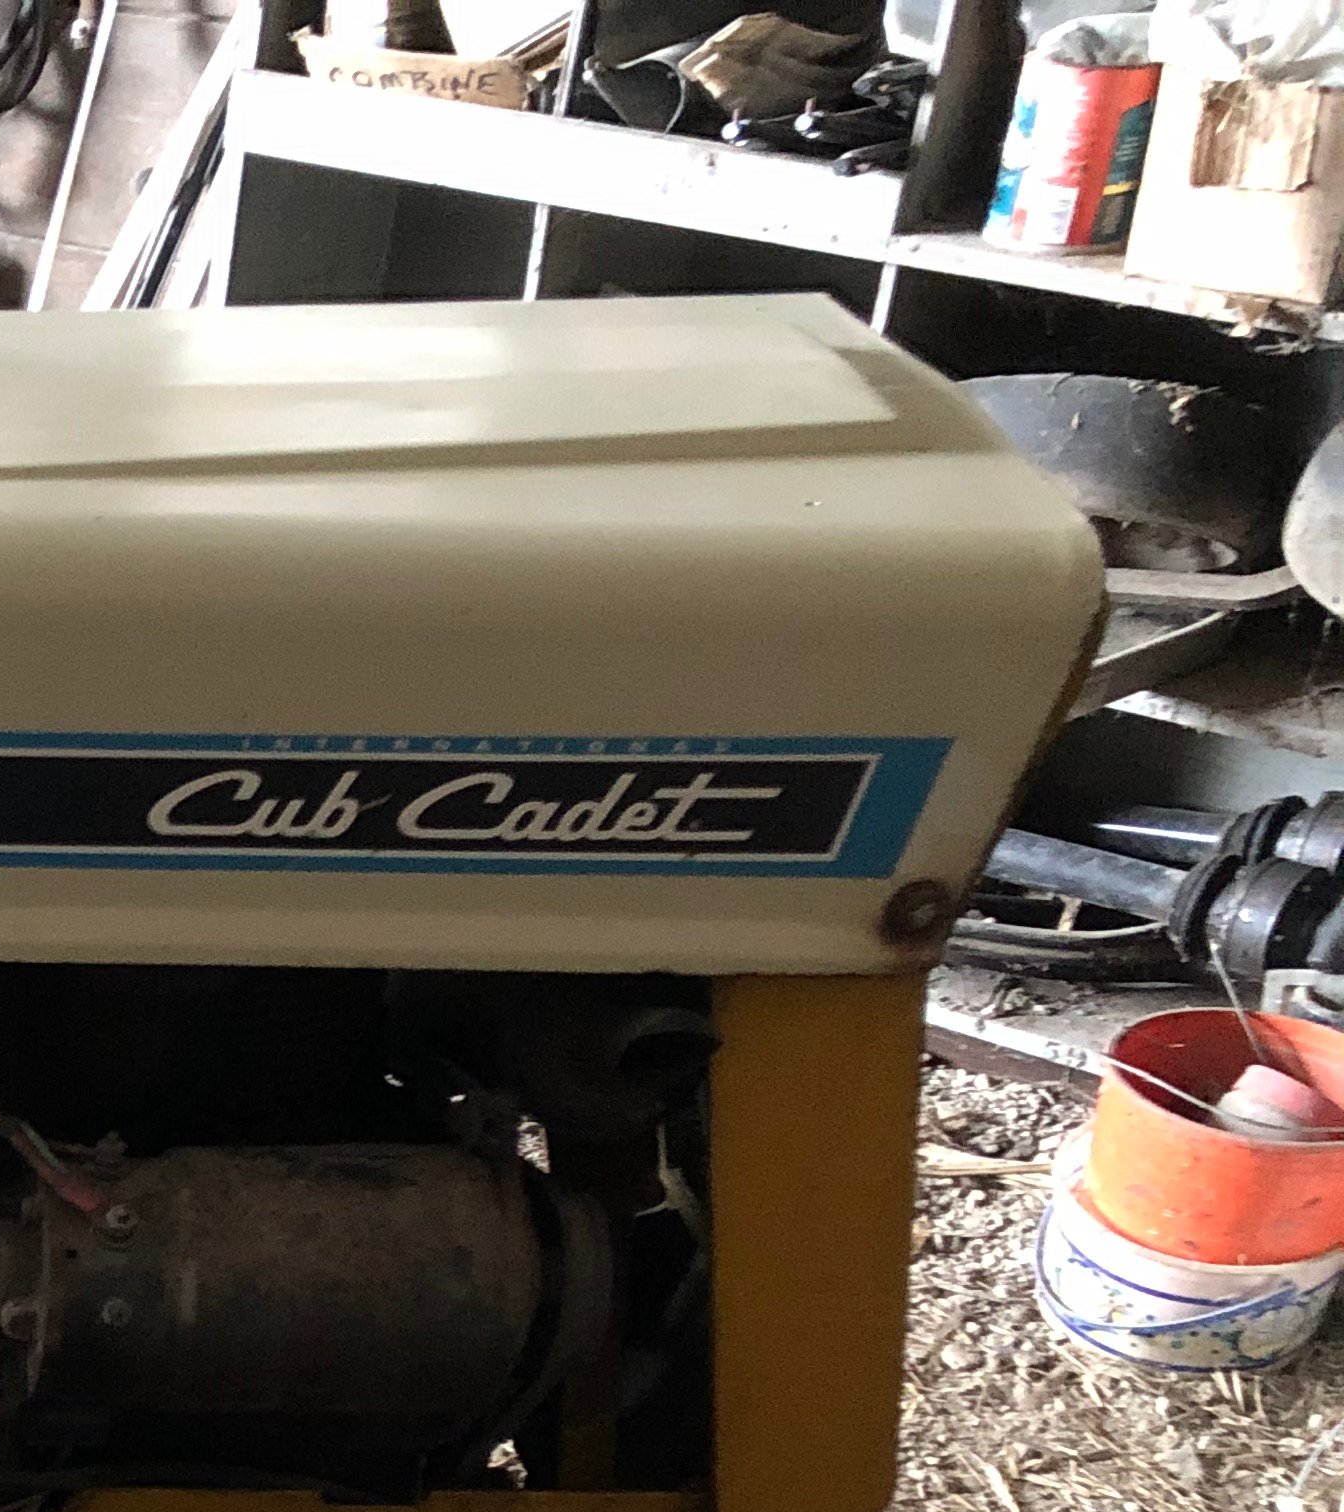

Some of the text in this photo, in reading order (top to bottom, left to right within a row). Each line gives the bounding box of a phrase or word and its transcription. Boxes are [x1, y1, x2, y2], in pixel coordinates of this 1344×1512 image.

[328, 66, 499, 96] COMBINE
[145, 769, 784, 842] Cub Cadet
